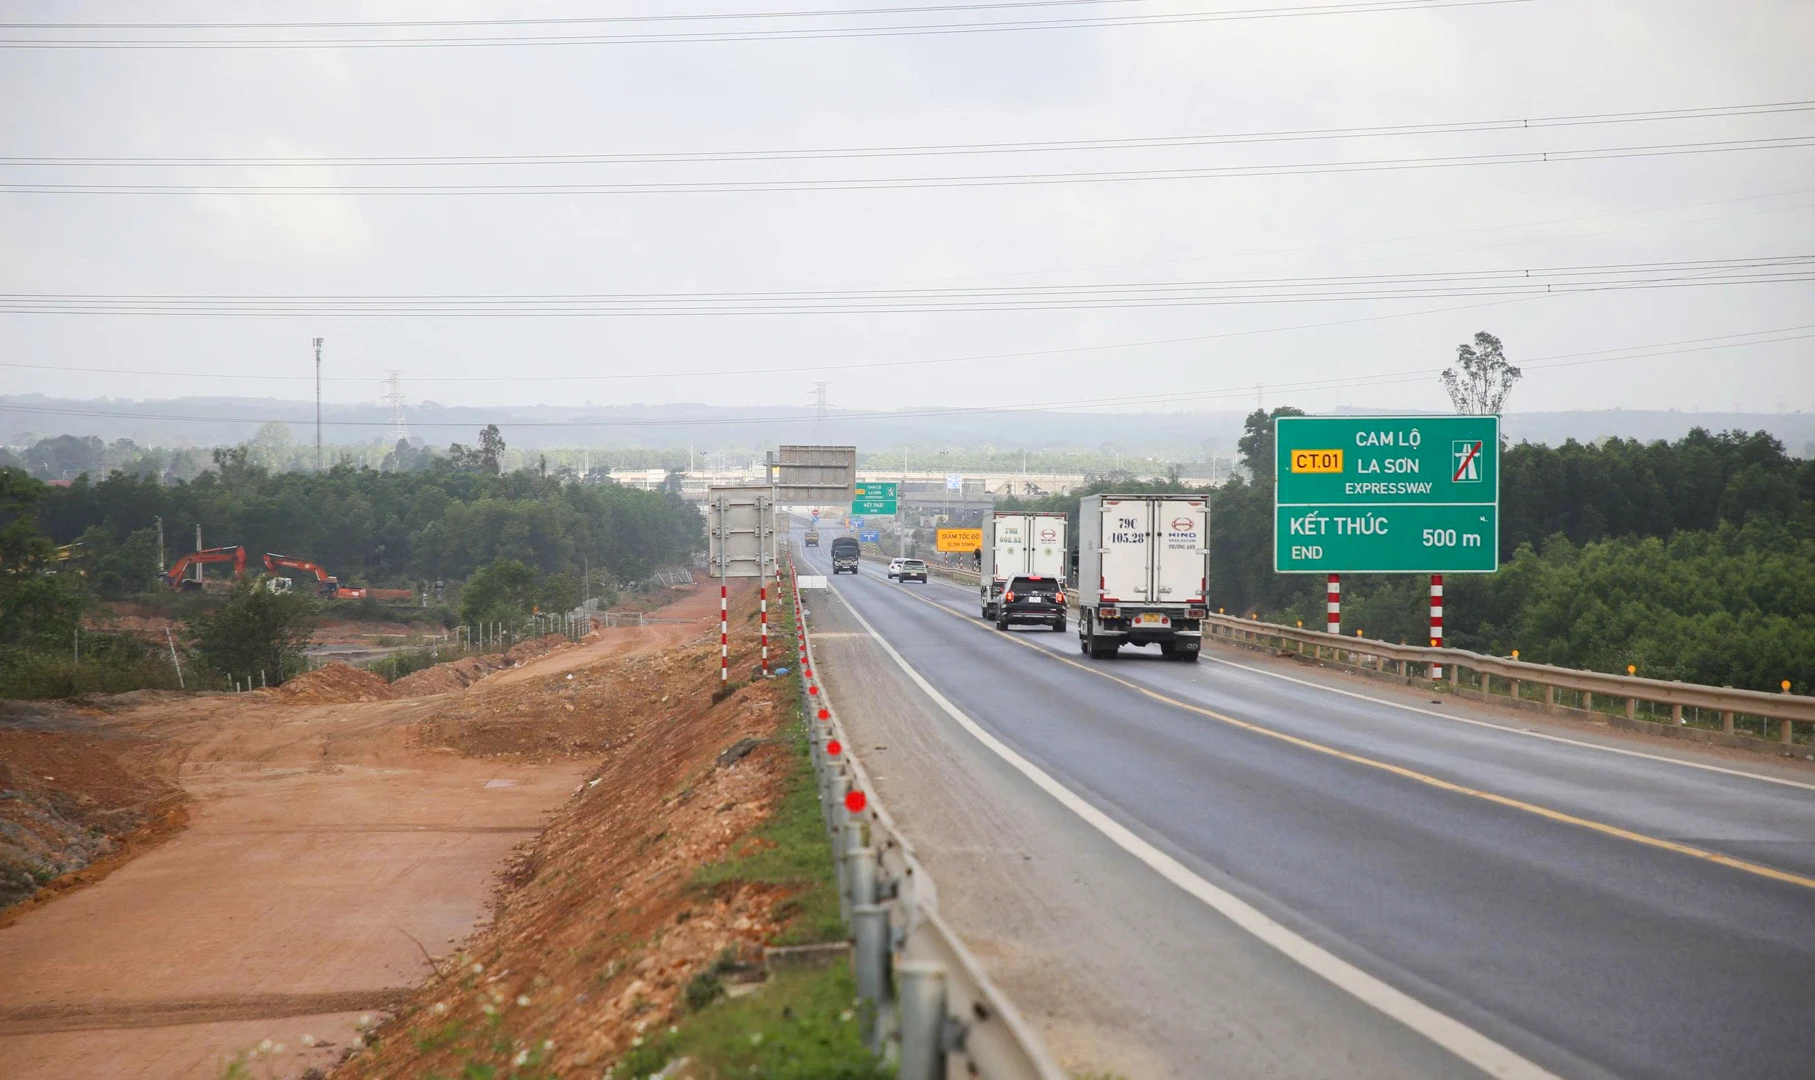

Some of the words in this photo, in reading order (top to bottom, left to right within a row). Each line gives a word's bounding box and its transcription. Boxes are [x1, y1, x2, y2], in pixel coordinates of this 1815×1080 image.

[1355, 431, 1394, 447] CAM
[1399, 428, 1421, 450] LỘ
[1296, 454, 1339, 469] CT.01
[1357, 459, 1381, 474] LA
[1384, 457, 1420, 474] SƠN
[1345, 482, 1432, 494] EXPRESSWAY
[1118, 518, 1138, 529] 79C
[1290, 510, 1330, 535] KẾT
[1334, 512, 1389, 535] THÚC
[1112, 532, 1144, 544] 105.28
[1422, 529, 1457, 547] 500
[1462, 533, 1481, 547] m
[1291, 546, 1323, 560] END
